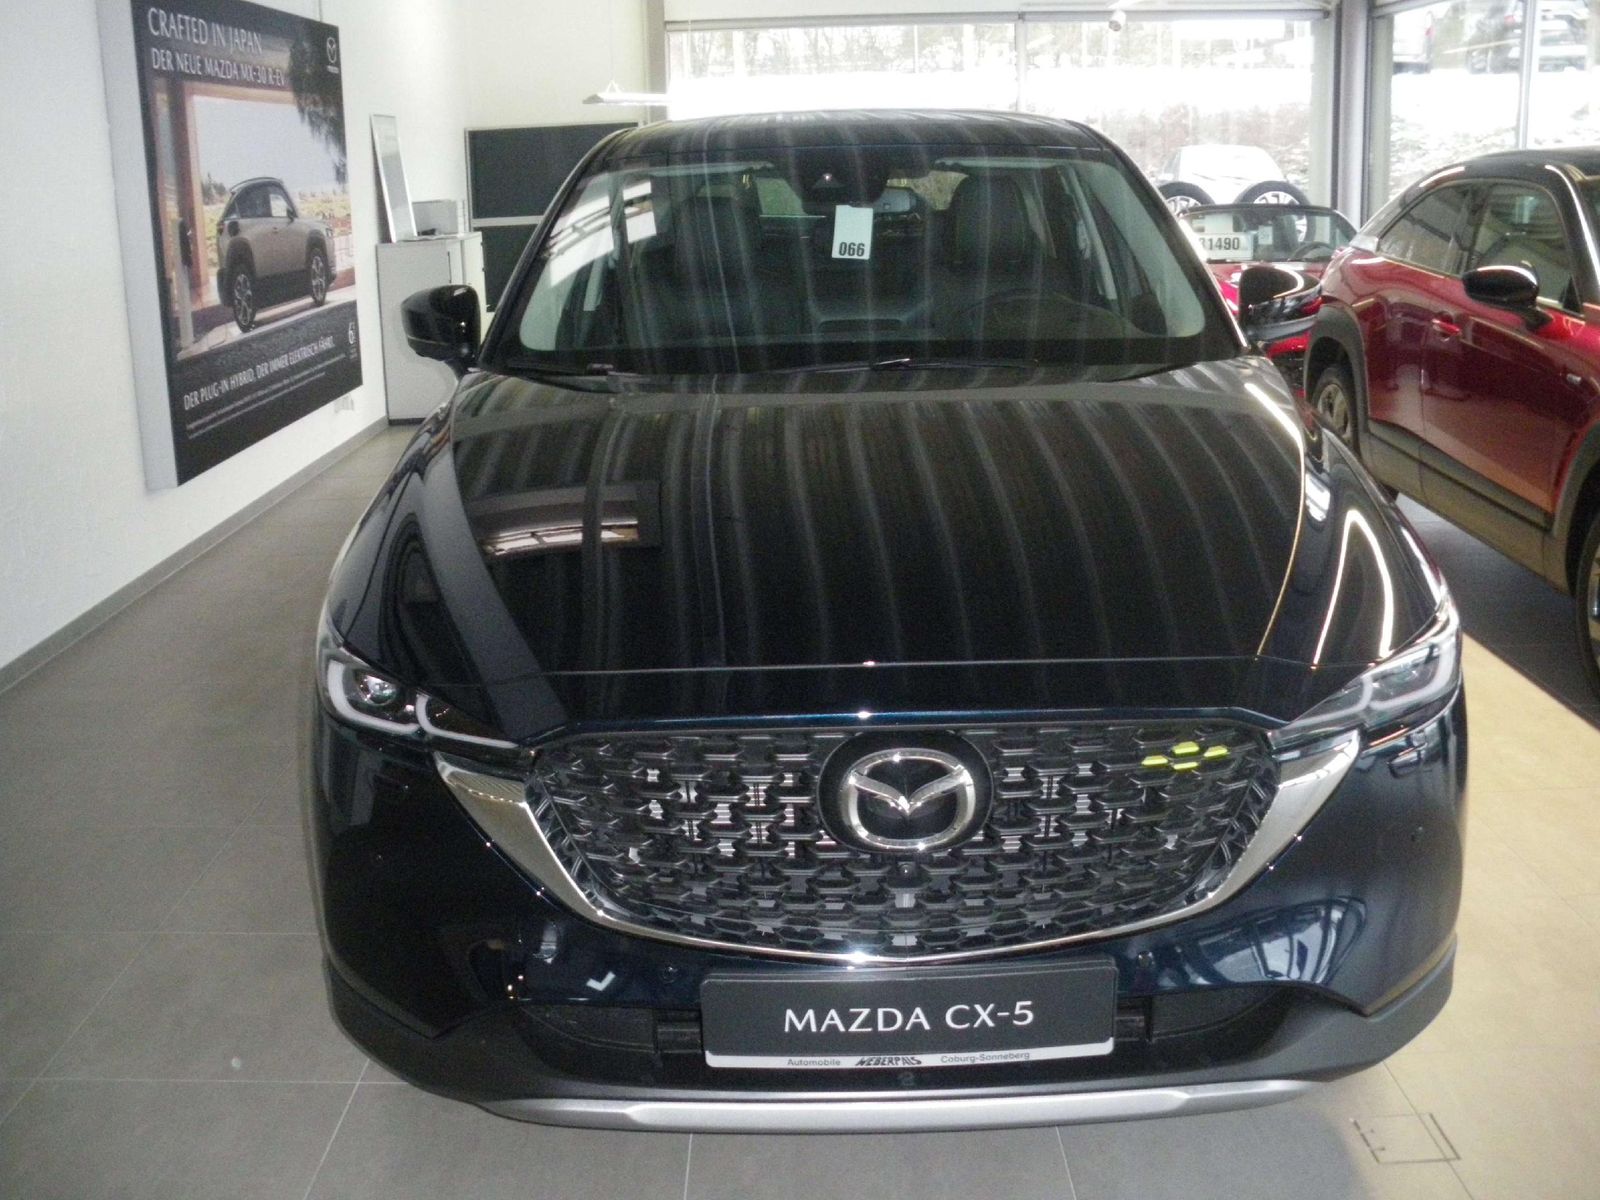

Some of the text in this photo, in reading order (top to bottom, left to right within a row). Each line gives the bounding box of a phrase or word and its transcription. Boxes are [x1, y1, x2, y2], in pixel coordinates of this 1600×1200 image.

[147, 7, 262, 54] CRAFTED IN JAPAN
[152, 48, 175, 71] DER
[175, 52, 202, 75] NEUE
[204, 57, 239, 80] MAZDA
[240, 63, 266, 84] MX-30
[839, 242, 865, 256] 066
[183, 391, 200, 411] DER
[200, 379, 229, 403] PLUG-IN
[256, 361, 269, 379] DER
[269, 353, 289, 373] IMMER
[784, 1001, 1034, 1033] MAZDA CX-5
[787, 1058, 841, 1067] Automobile
[940, 1051, 1031, 1064] Coburg-Sonneberg
